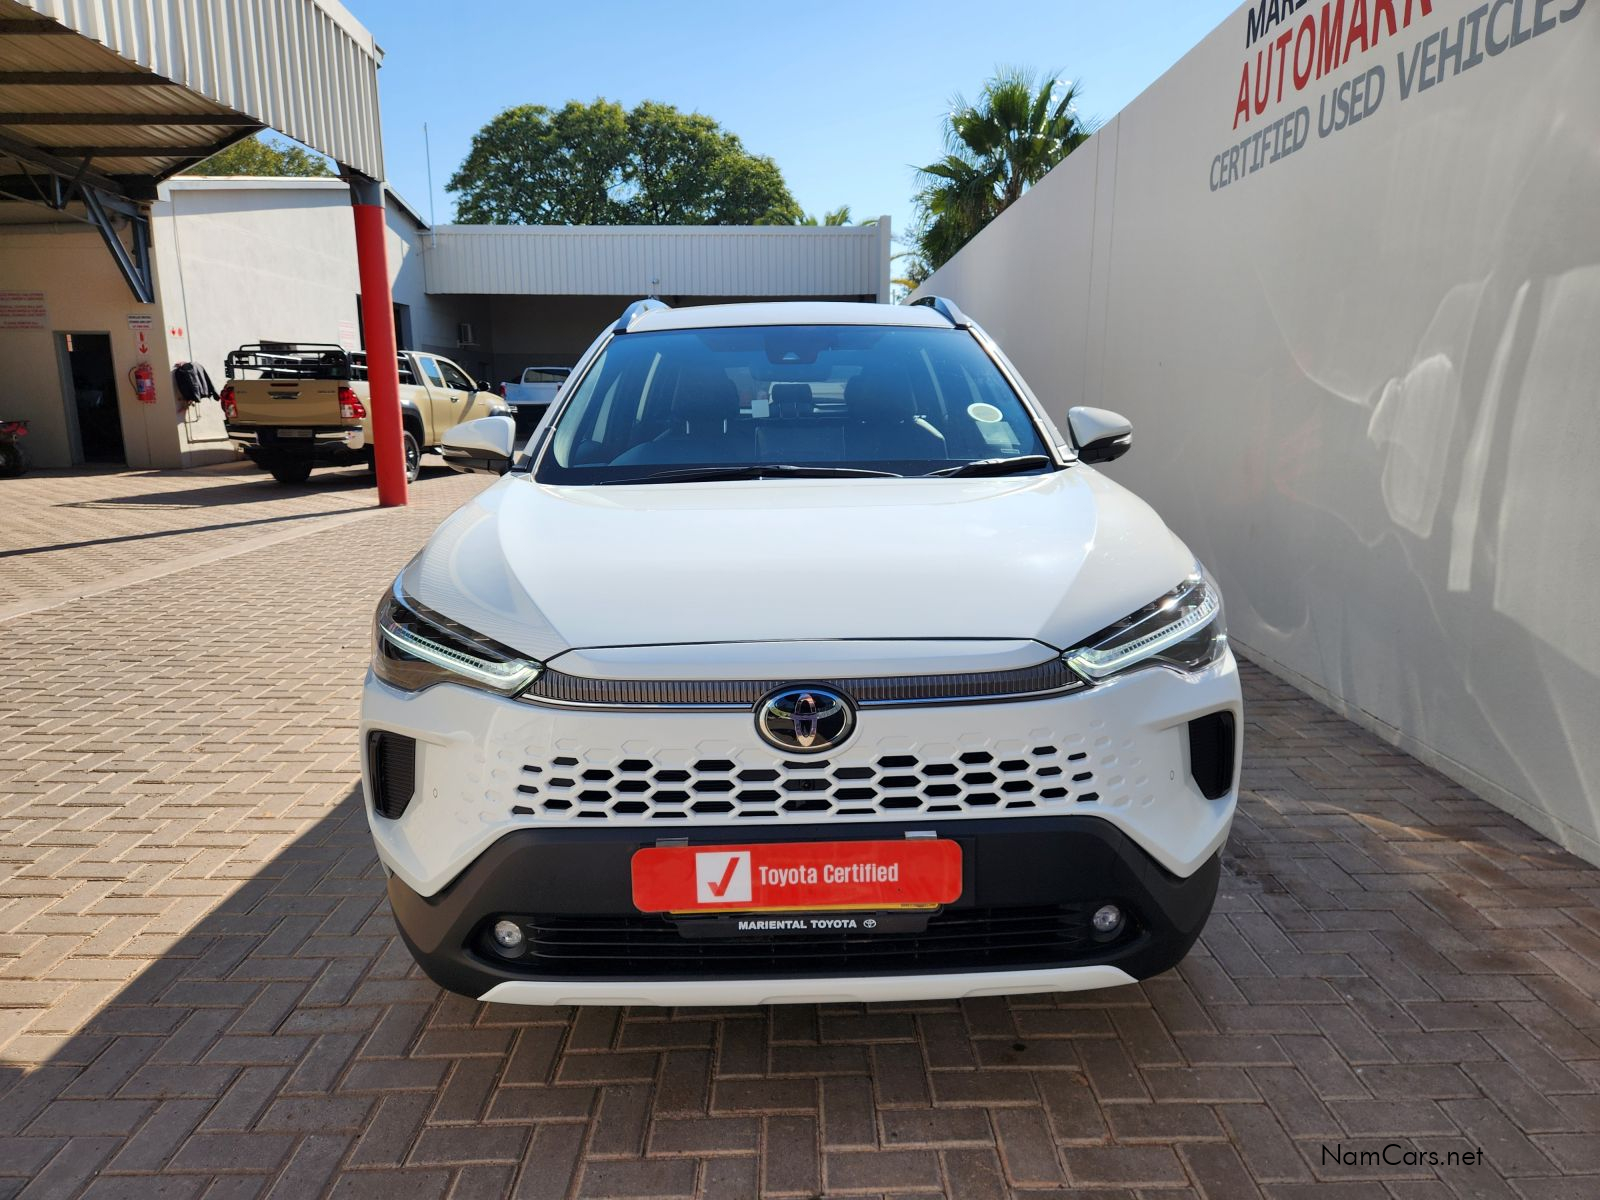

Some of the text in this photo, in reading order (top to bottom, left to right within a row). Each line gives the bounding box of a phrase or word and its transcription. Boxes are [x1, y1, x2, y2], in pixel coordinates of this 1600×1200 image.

[1209, 106, 1310, 193] CERTIFIED
[1317, 65, 1385, 139] USED
[758, 863, 899, 887] Toyota Certified
[738, 919, 857, 930] MARIENTAL TOYOTA
